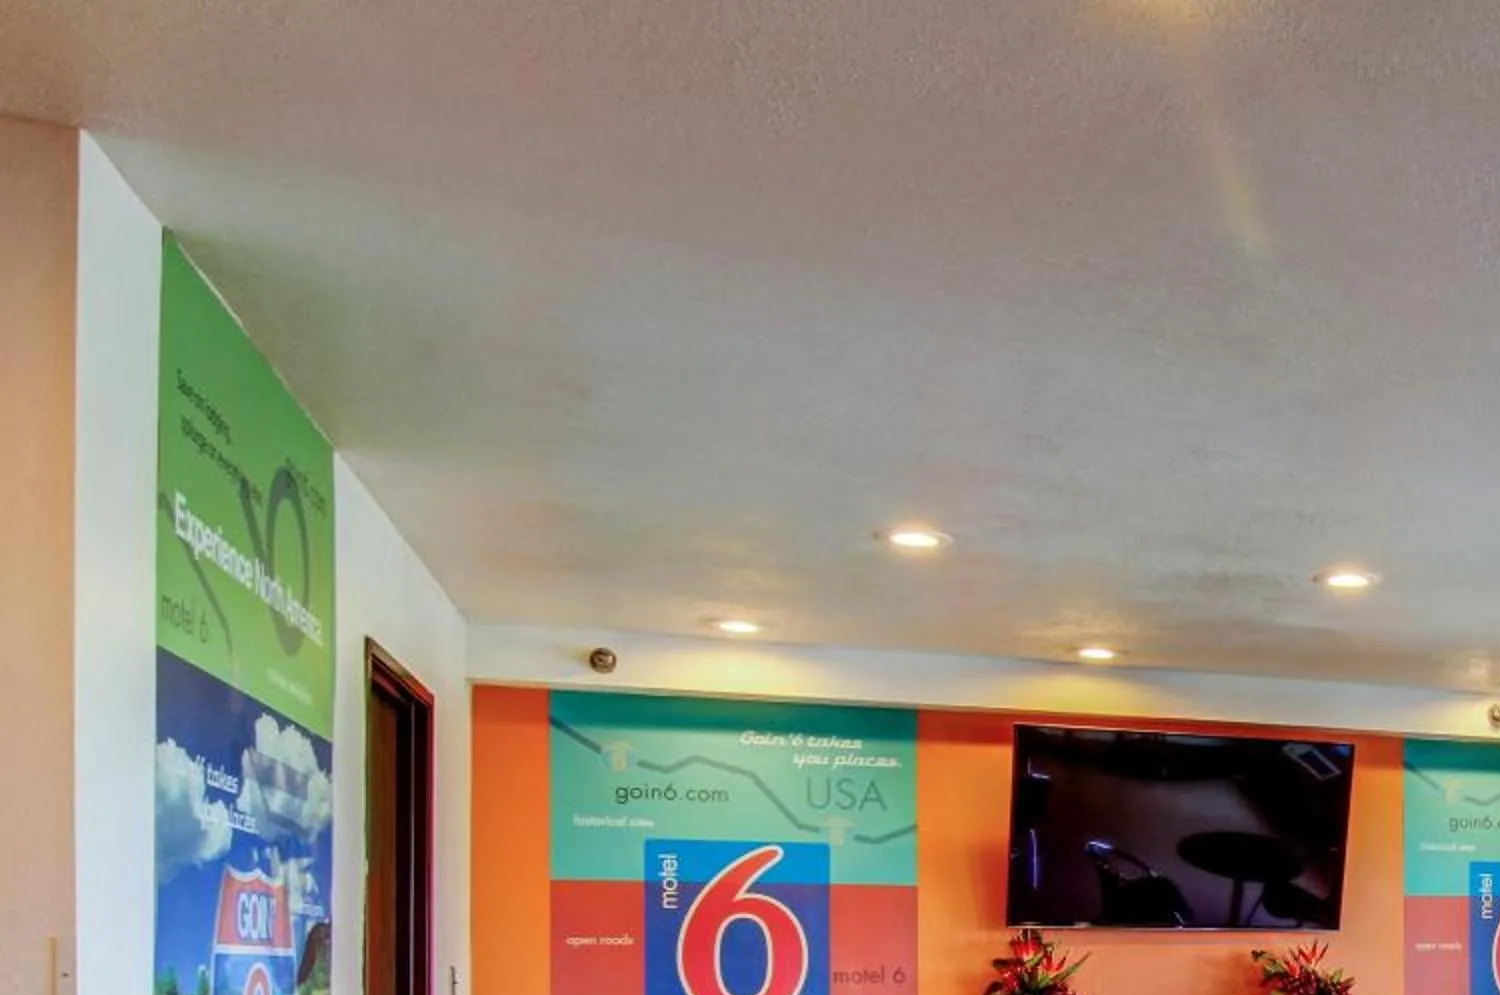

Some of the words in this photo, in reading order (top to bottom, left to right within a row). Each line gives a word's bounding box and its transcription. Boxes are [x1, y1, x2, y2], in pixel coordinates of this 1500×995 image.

[807, 735, 863, 750] takes
[793, 753, 829, 769] you
[615, 781, 731, 805] goin6.com
[807, 776, 888, 812] USA
[658, 853, 679, 910] motel
[1480, 873, 1494, 919] motel
[833, 965, 885, 985] motel
[893, 966, 906, 984] 6
